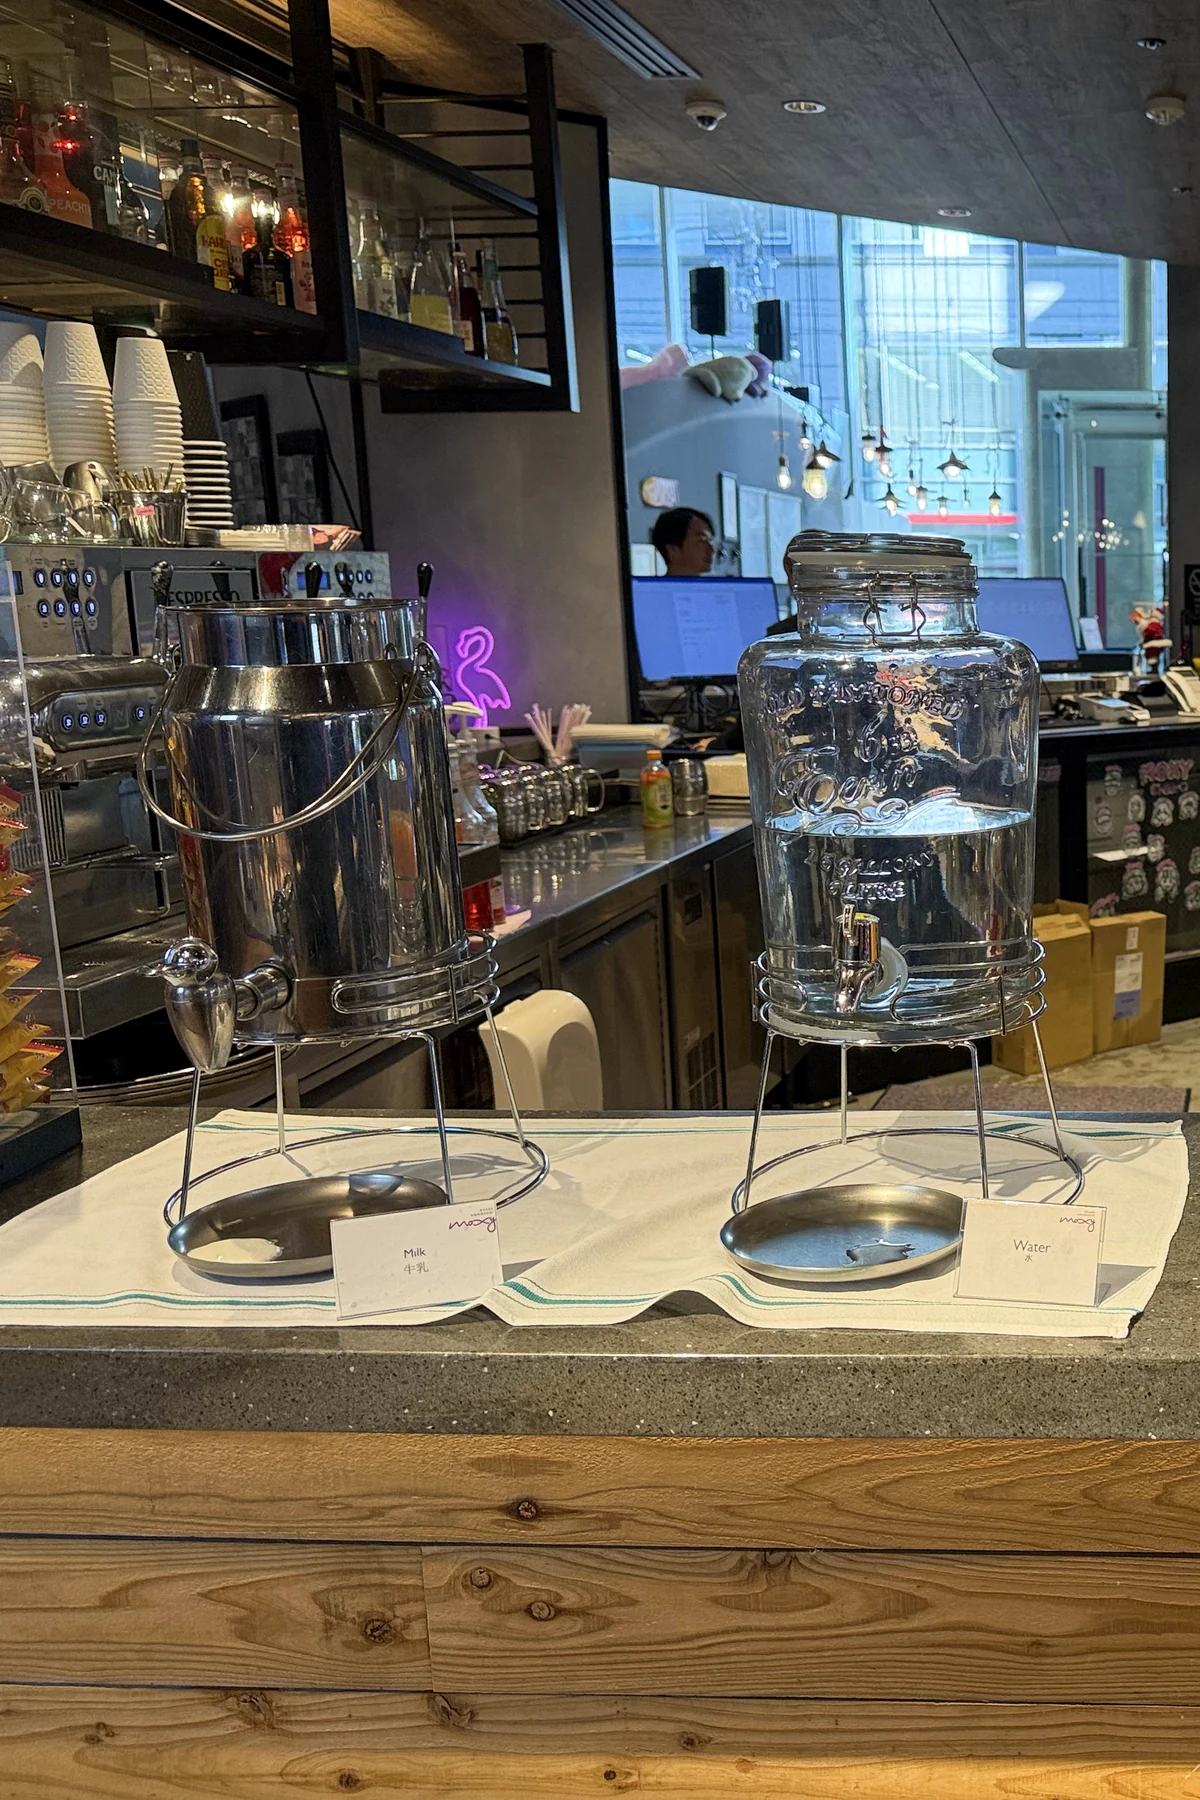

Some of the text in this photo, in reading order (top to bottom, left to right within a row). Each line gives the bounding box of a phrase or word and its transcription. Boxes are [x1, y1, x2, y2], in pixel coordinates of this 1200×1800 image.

[403, 1247, 427, 1259] Milk
[1013, 1239, 1051, 1254] Water
[1024, 1254, 1033, 1263] 水
[403, 1261, 429, 1275] 牛乳
